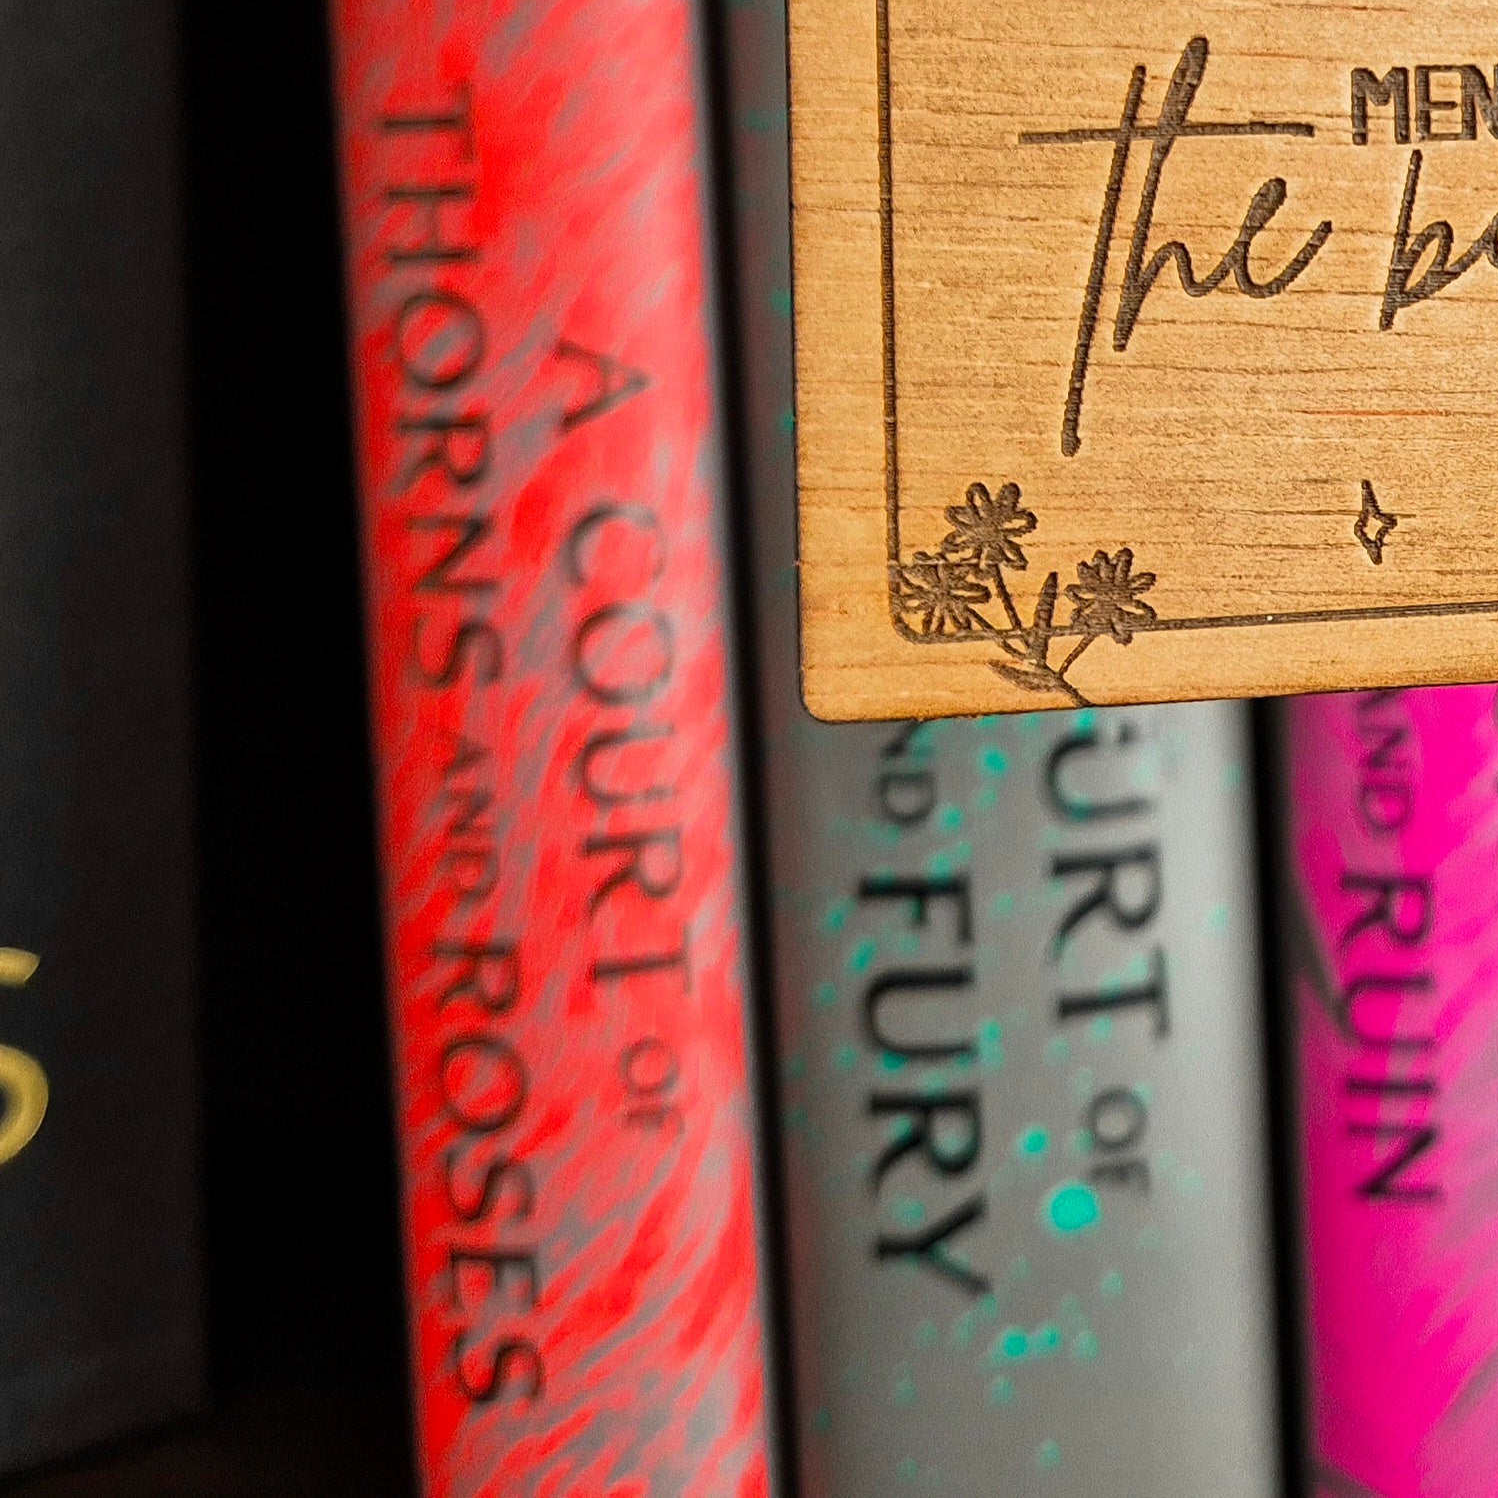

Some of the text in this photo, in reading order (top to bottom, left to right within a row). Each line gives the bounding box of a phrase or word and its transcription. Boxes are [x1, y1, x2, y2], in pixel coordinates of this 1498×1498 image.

[553, 338, 651, 437] A
[1017, 35, 1333, 458] the
[380, 79, 545, 1405] THORNS AND ROSES
[565, 503, 695, 996] COURT
[856, 870, 989, 1300] FURY
[1338, 869, 1443, 1206] RUIN
